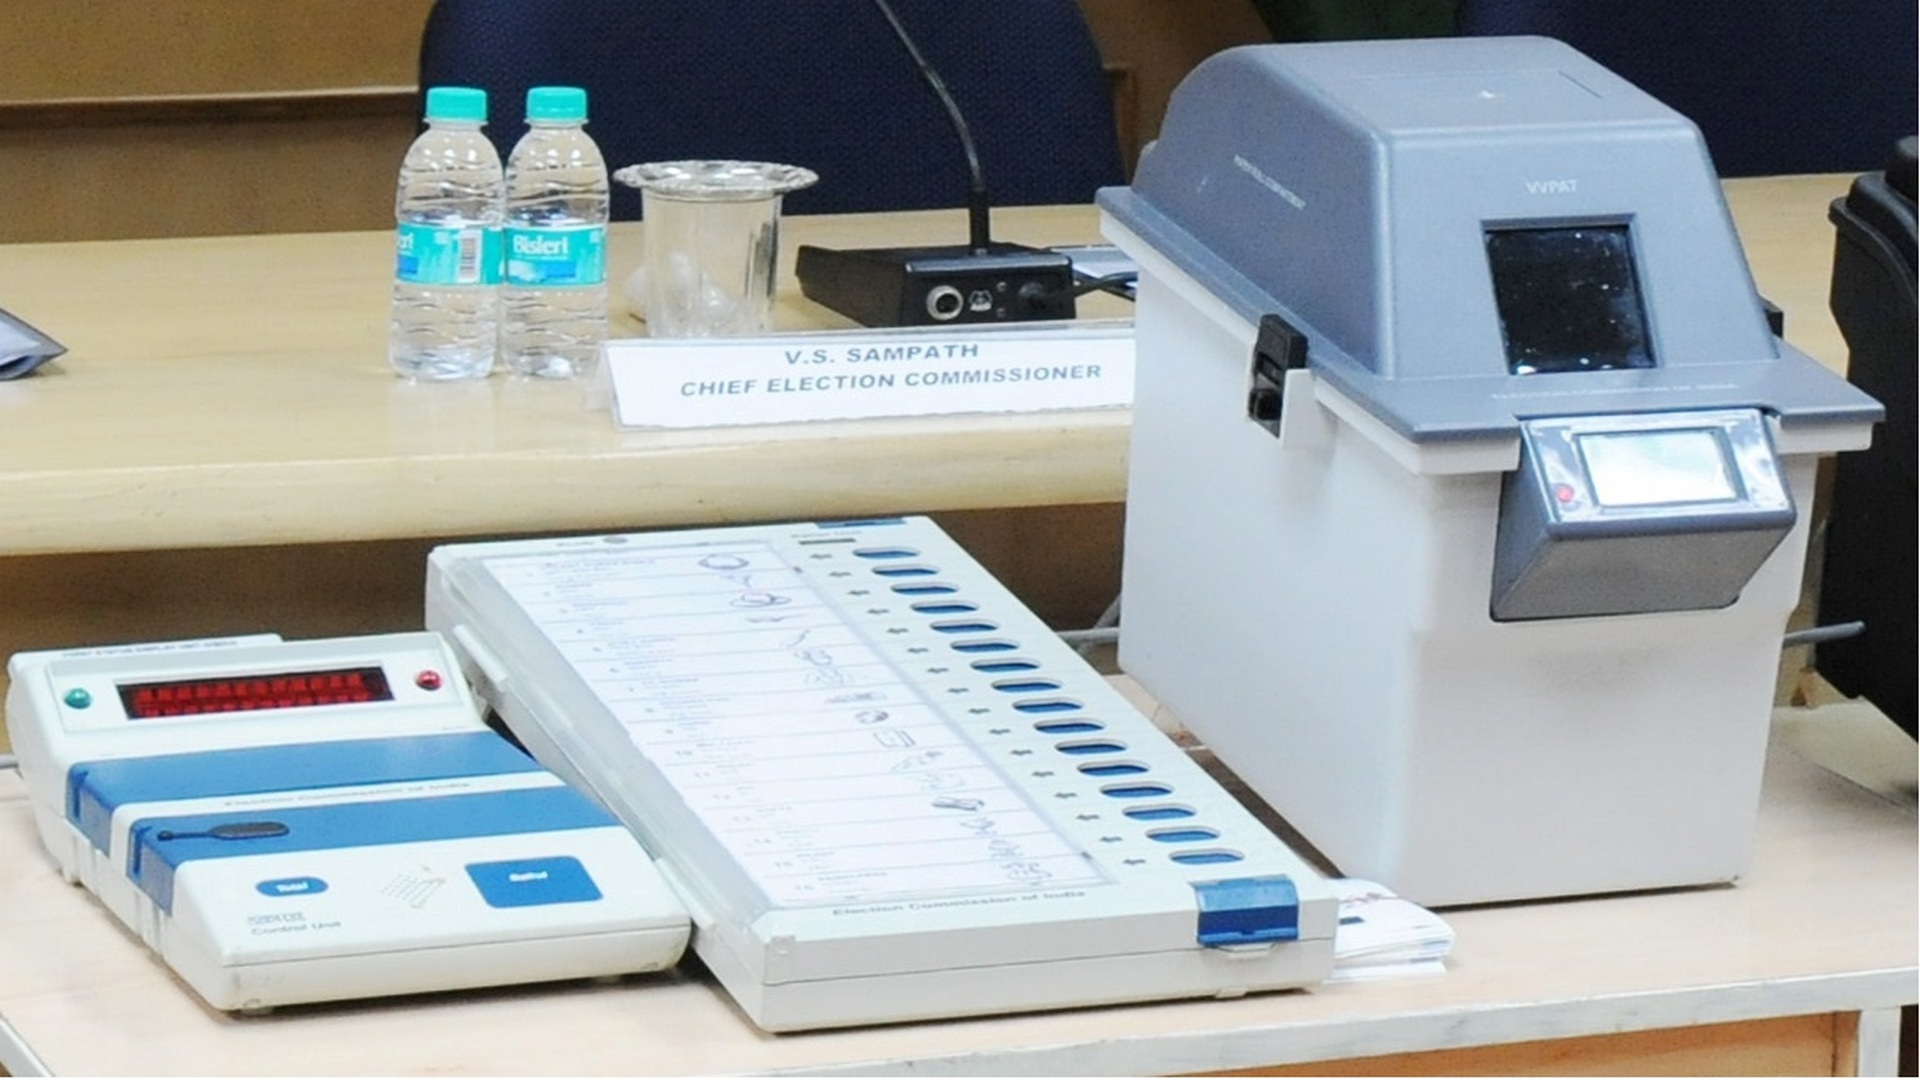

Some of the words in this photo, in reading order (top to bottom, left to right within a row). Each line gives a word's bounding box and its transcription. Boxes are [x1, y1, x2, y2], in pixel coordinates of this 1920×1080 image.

[513, 234, 568, 254] Bisleri
[784, 350, 835, 365] V.S.
[846, 343, 980, 364] SAMPATH
[680, 379, 758, 397] CHIEF
[766, 373, 896, 393] ELECTION
[904, 364, 1102, 388] COMMISSIONER
